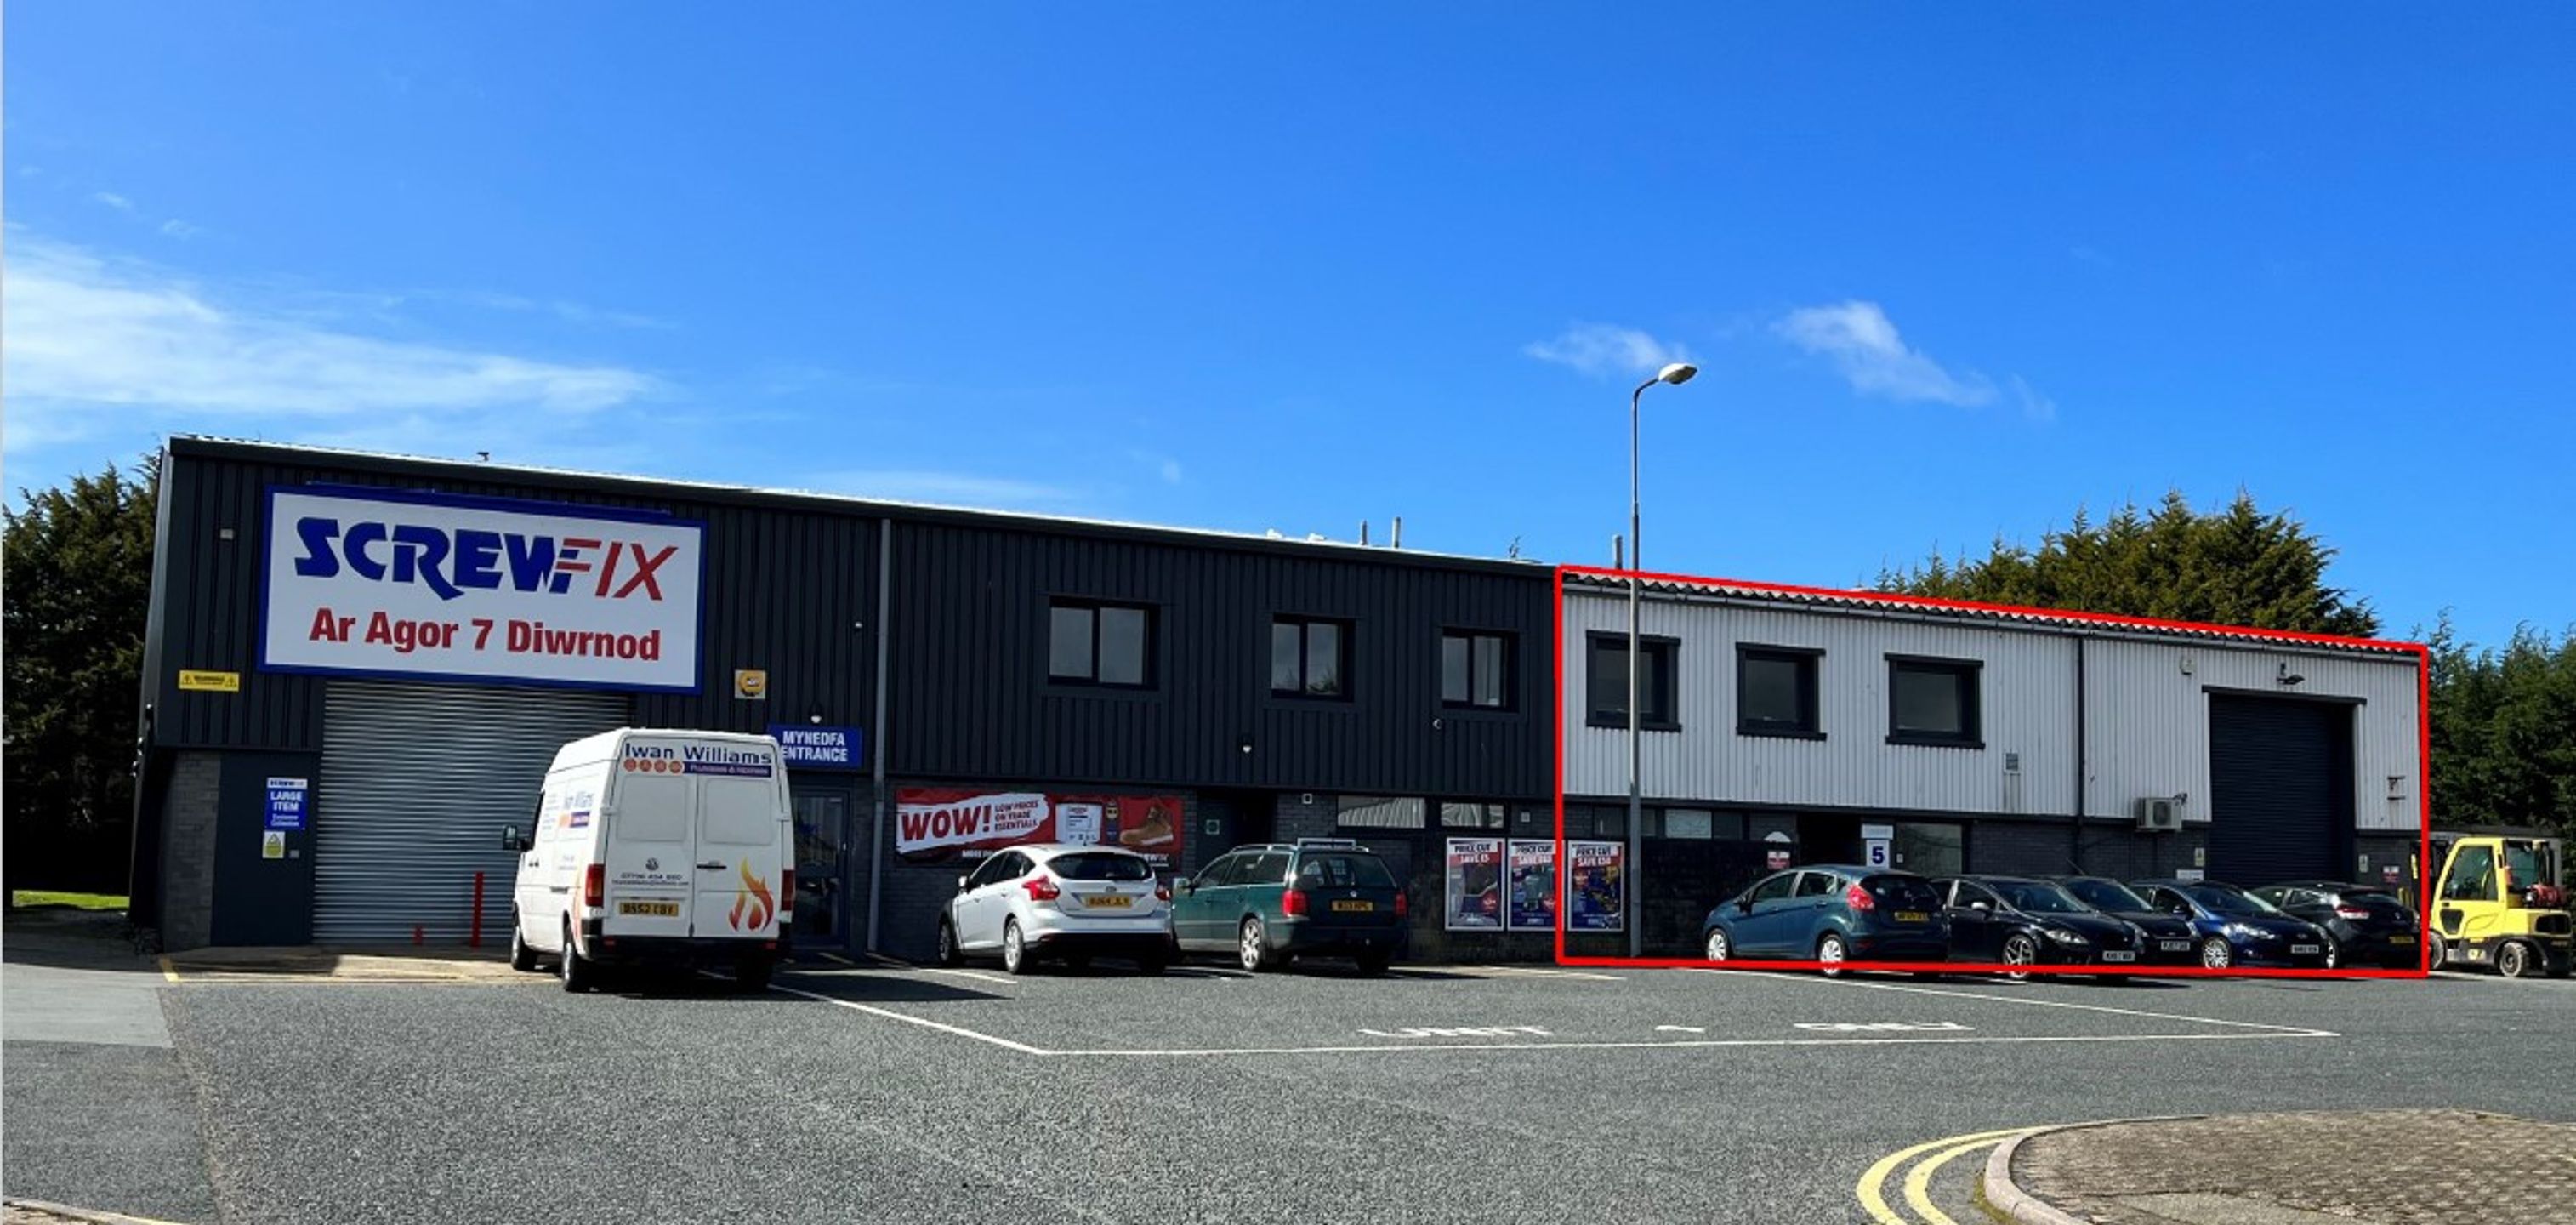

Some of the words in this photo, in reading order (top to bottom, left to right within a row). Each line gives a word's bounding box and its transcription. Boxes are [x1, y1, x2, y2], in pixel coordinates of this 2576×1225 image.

[294, 516, 680, 601] SCREWFIX
[309, 607, 355, 643] Ar
[365, 611, 459, 653] Agor
[471, 619, 494, 651] 7
[507, 620, 661, 661] Diwrnod
[782, 731, 845, 746] MYNEDFA
[625, 743, 674, 760] Iwan
[684, 744, 772, 764] Williams
[781, 745, 848, 761] ENTRANCE
[270, 791, 302, 801] LARGE
[273, 801, 299, 812] ITEM
[901, 805, 992, 841] WOW!
[1872, 846, 1885, 864] 5
